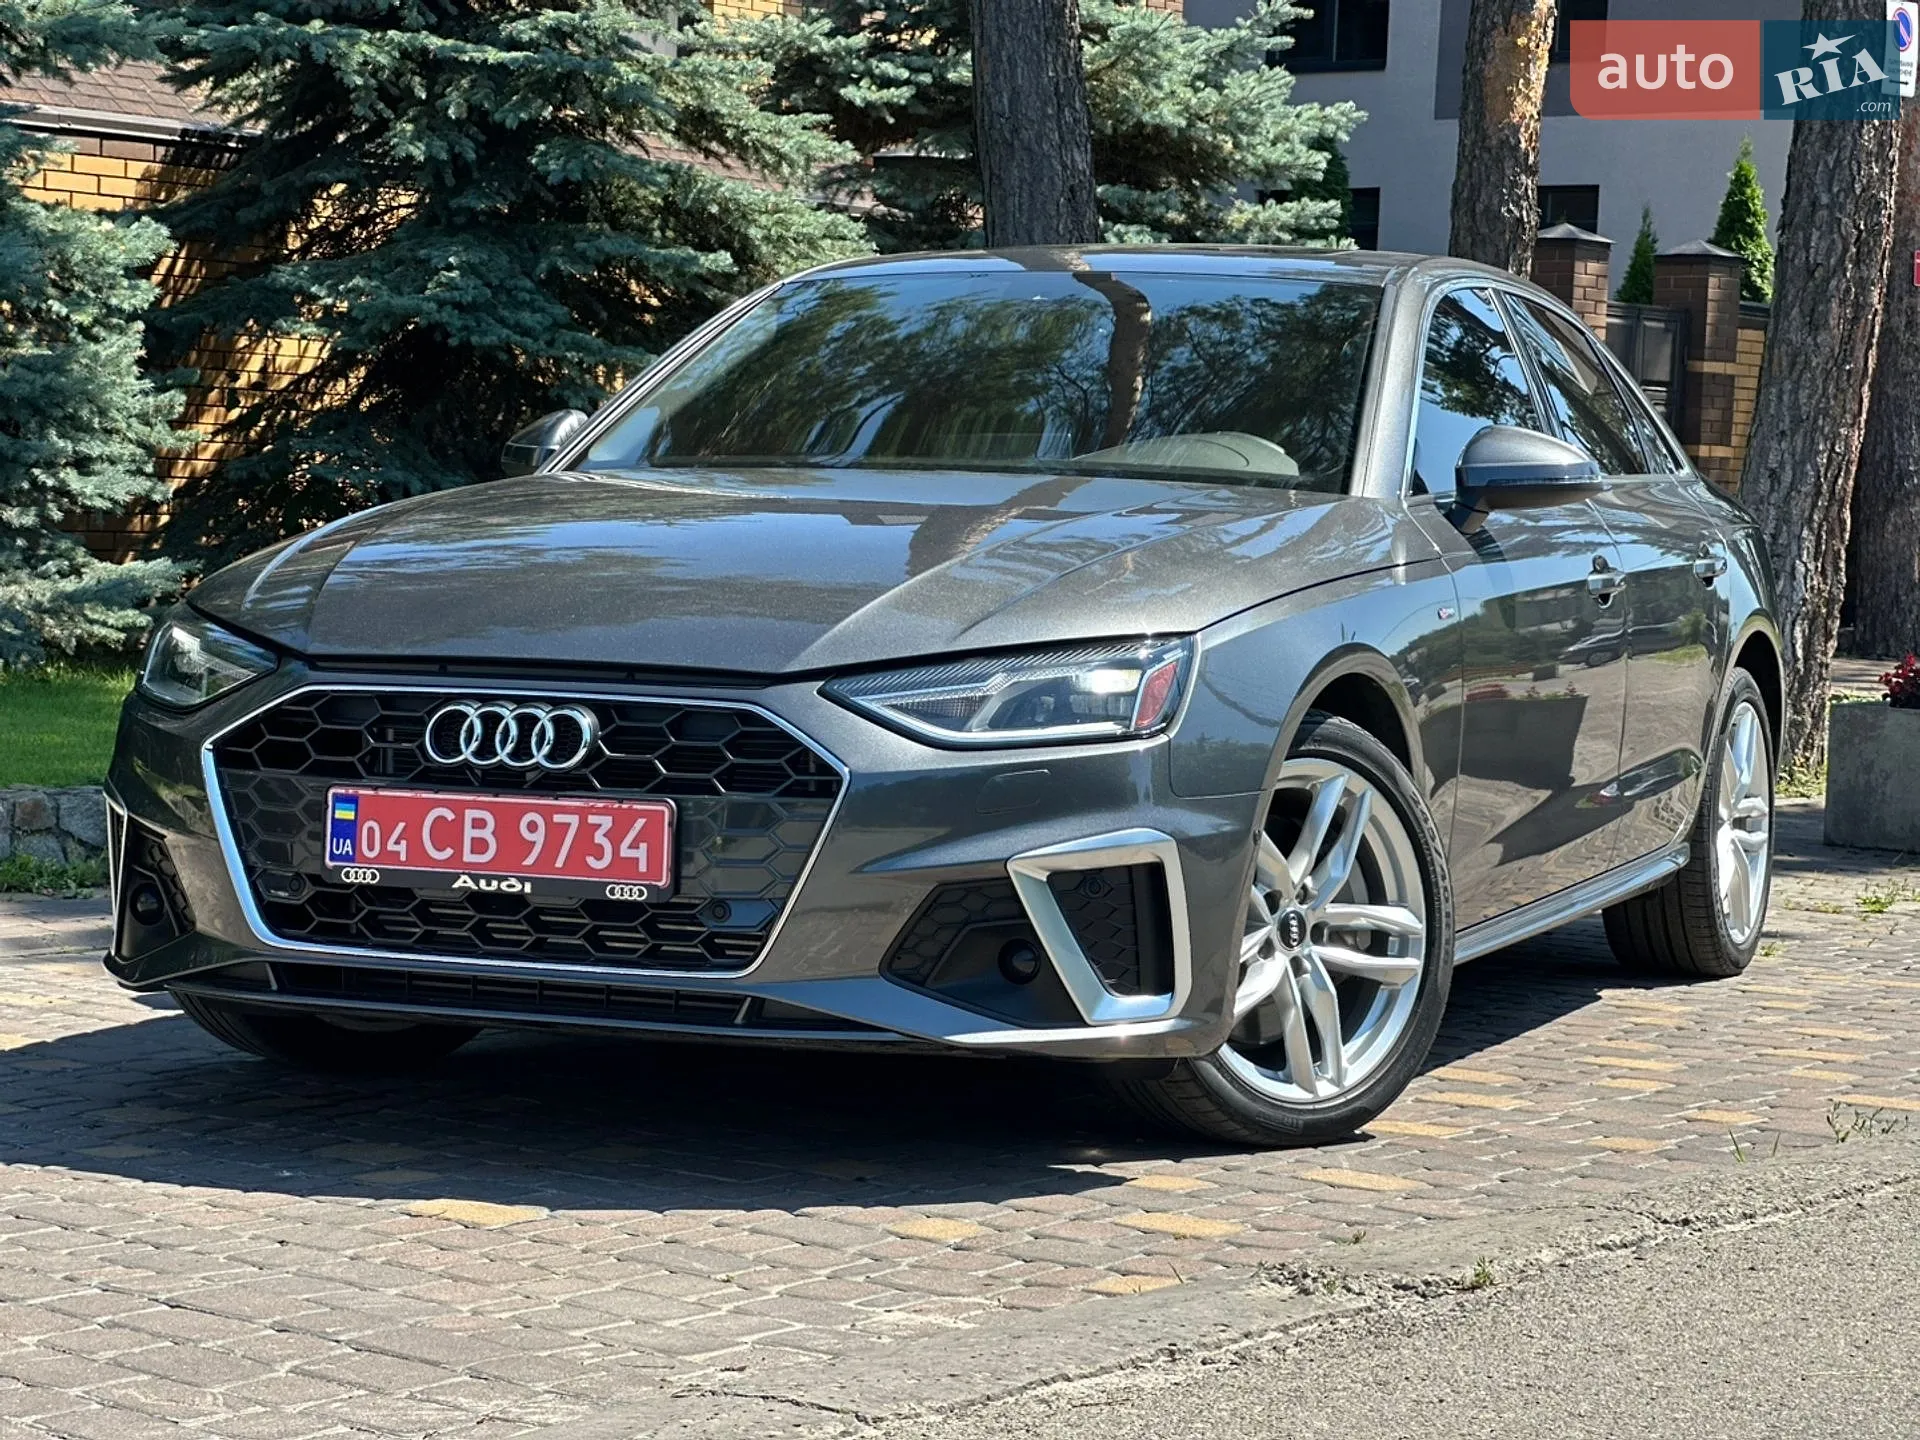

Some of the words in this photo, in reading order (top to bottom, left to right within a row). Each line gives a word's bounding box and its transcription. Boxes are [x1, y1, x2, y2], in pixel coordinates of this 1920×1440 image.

[332, 837, 353, 856] UA
[360, 820, 407, 861] 04
[421, 807, 497, 863] CB
[518, 811, 648, 873] 9734
[451, 874, 532, 894] Audi
